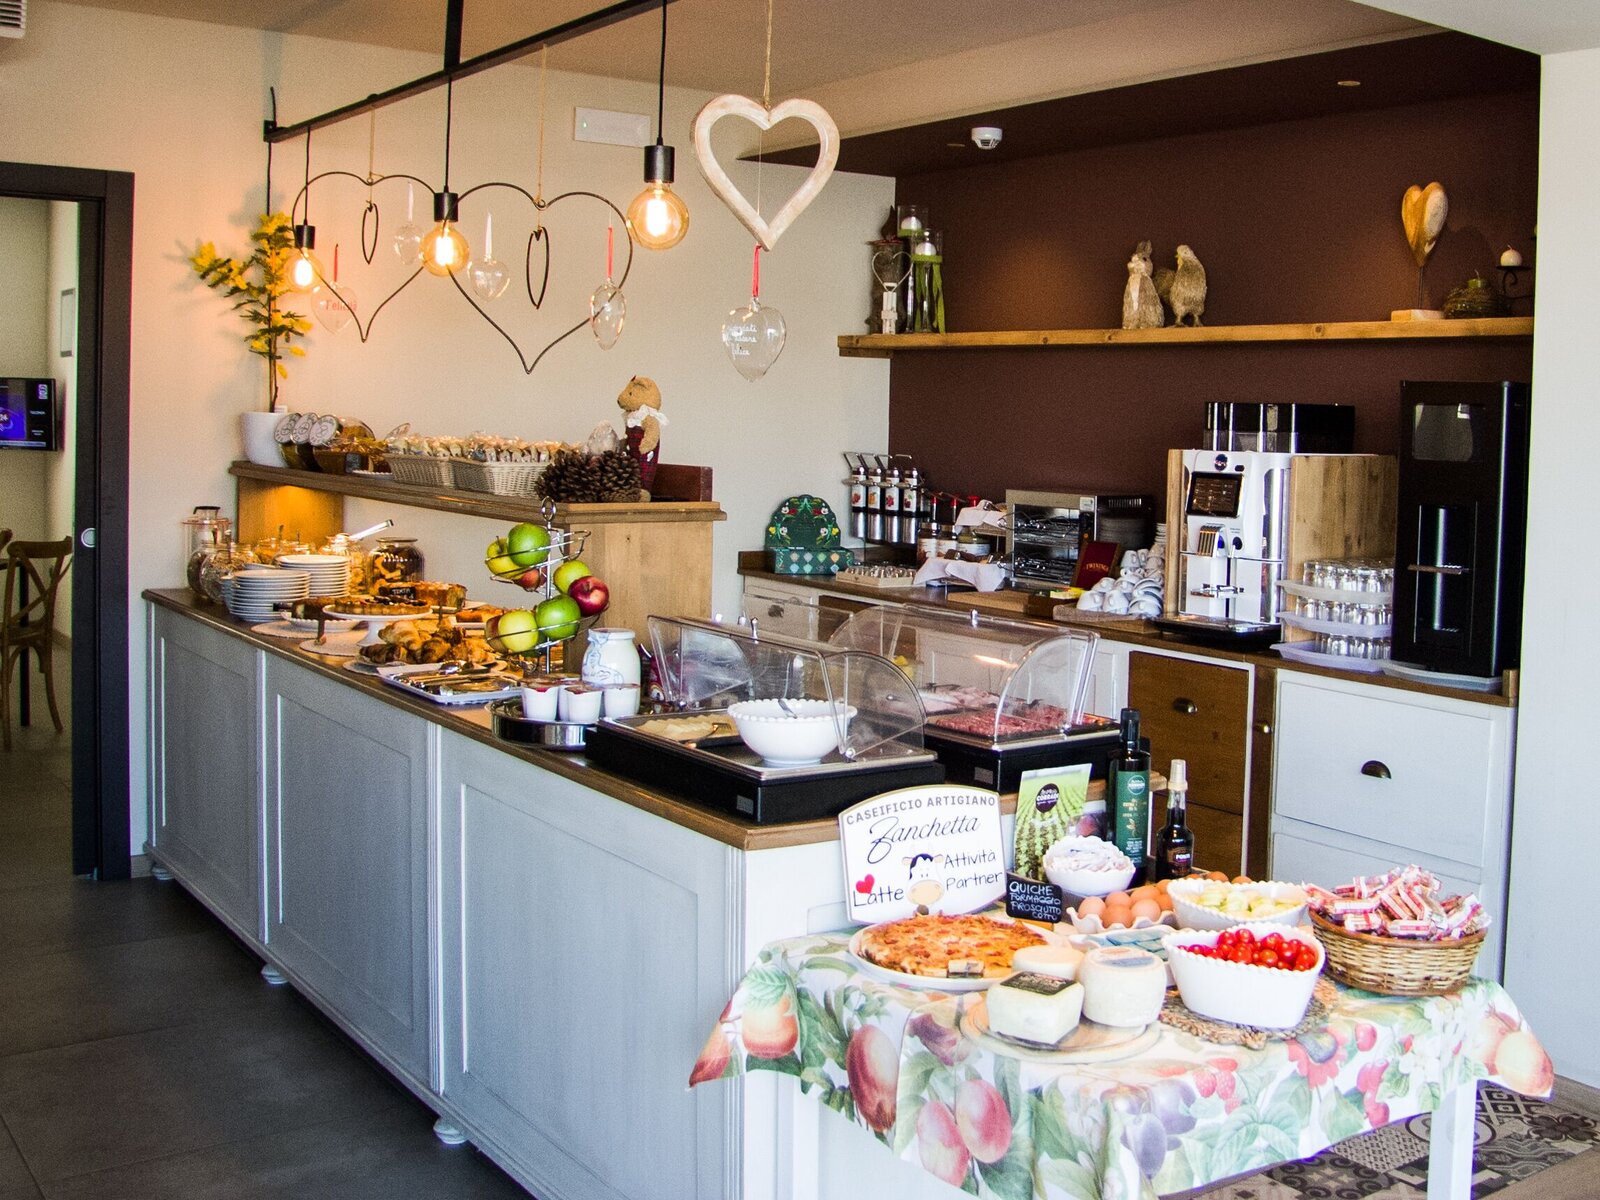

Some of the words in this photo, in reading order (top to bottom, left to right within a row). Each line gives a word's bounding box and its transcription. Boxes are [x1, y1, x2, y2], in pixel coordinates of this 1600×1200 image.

[846, 798, 923, 825] CASEIFICIO
[927, 795, 996, 807] ARTIGIANO
[867, 815, 980, 864] Zanchetta
[944, 849, 996, 869] Attività
[946, 872, 1003, 890] Partner
[1009, 881, 1054, 896] QUICHE
[853, 885, 904, 907] Latte
[1010, 892, 1061, 905] FORMAGGIO
[1032, 911, 1058, 920] COTTO
